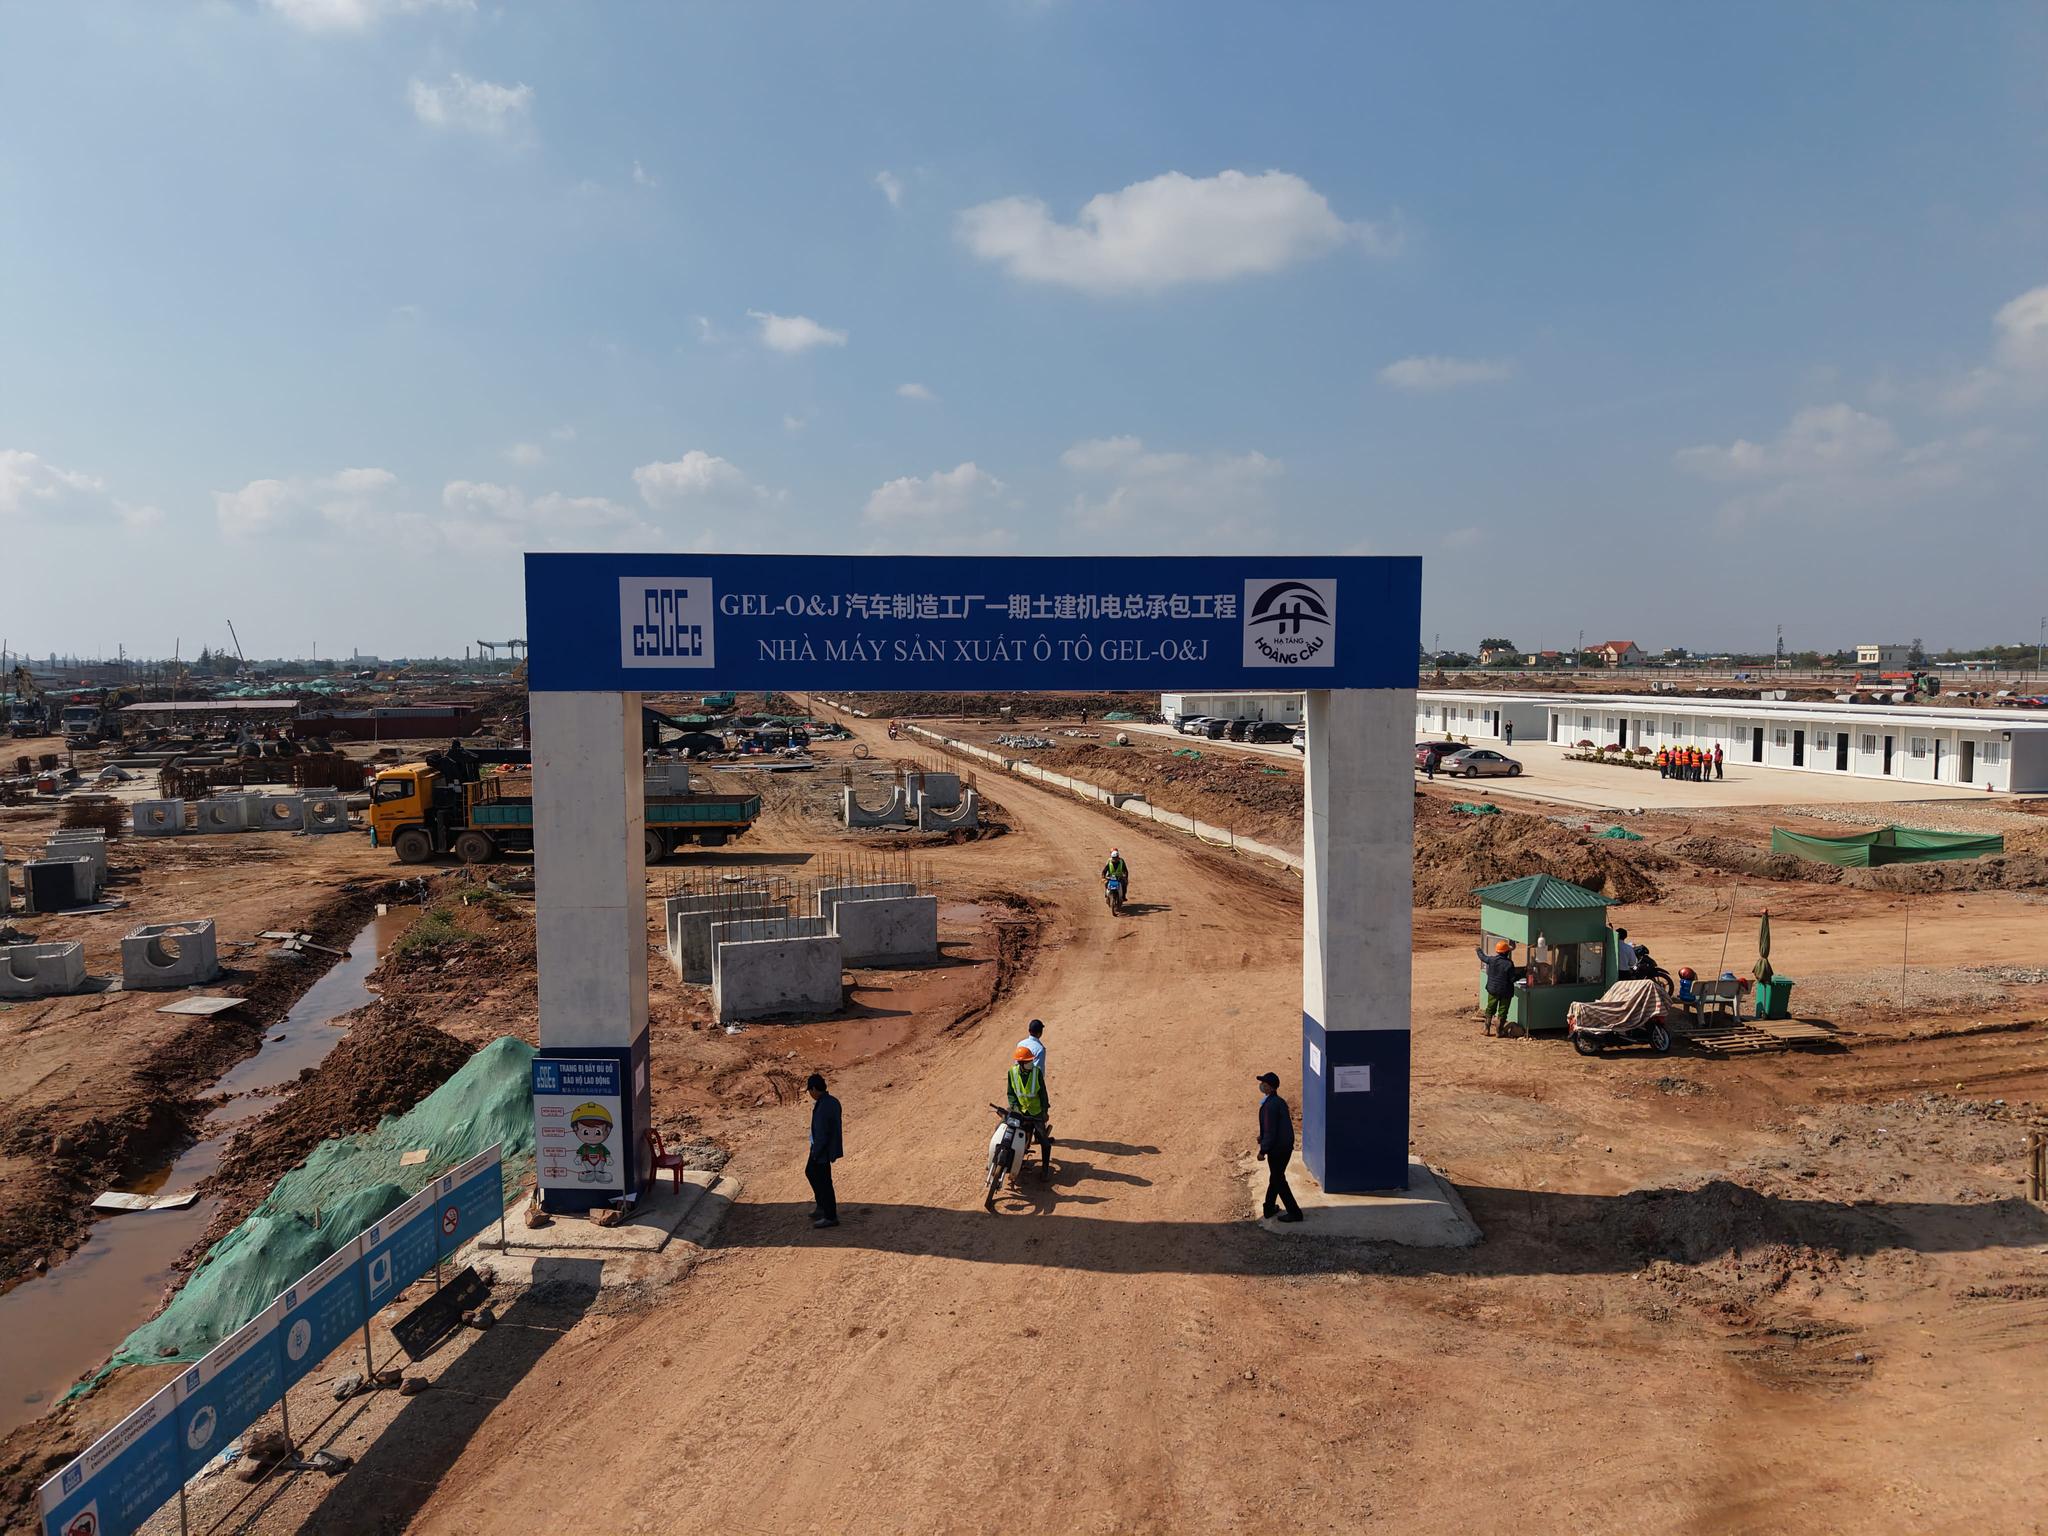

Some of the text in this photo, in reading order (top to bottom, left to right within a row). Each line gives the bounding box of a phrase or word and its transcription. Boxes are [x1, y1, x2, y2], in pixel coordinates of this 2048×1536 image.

[719, 593, 1237, 620] GEL-O&J 汽车制造工厂一期土建机电总承包工程
[758, 633, 1209, 662] NHÀ MÁY SẢN XUẤT Ô TÔ GEL-O&J
[1255, 636, 1297, 664] HOÀNG
[560, 1064, 578, 1073] TRANG
